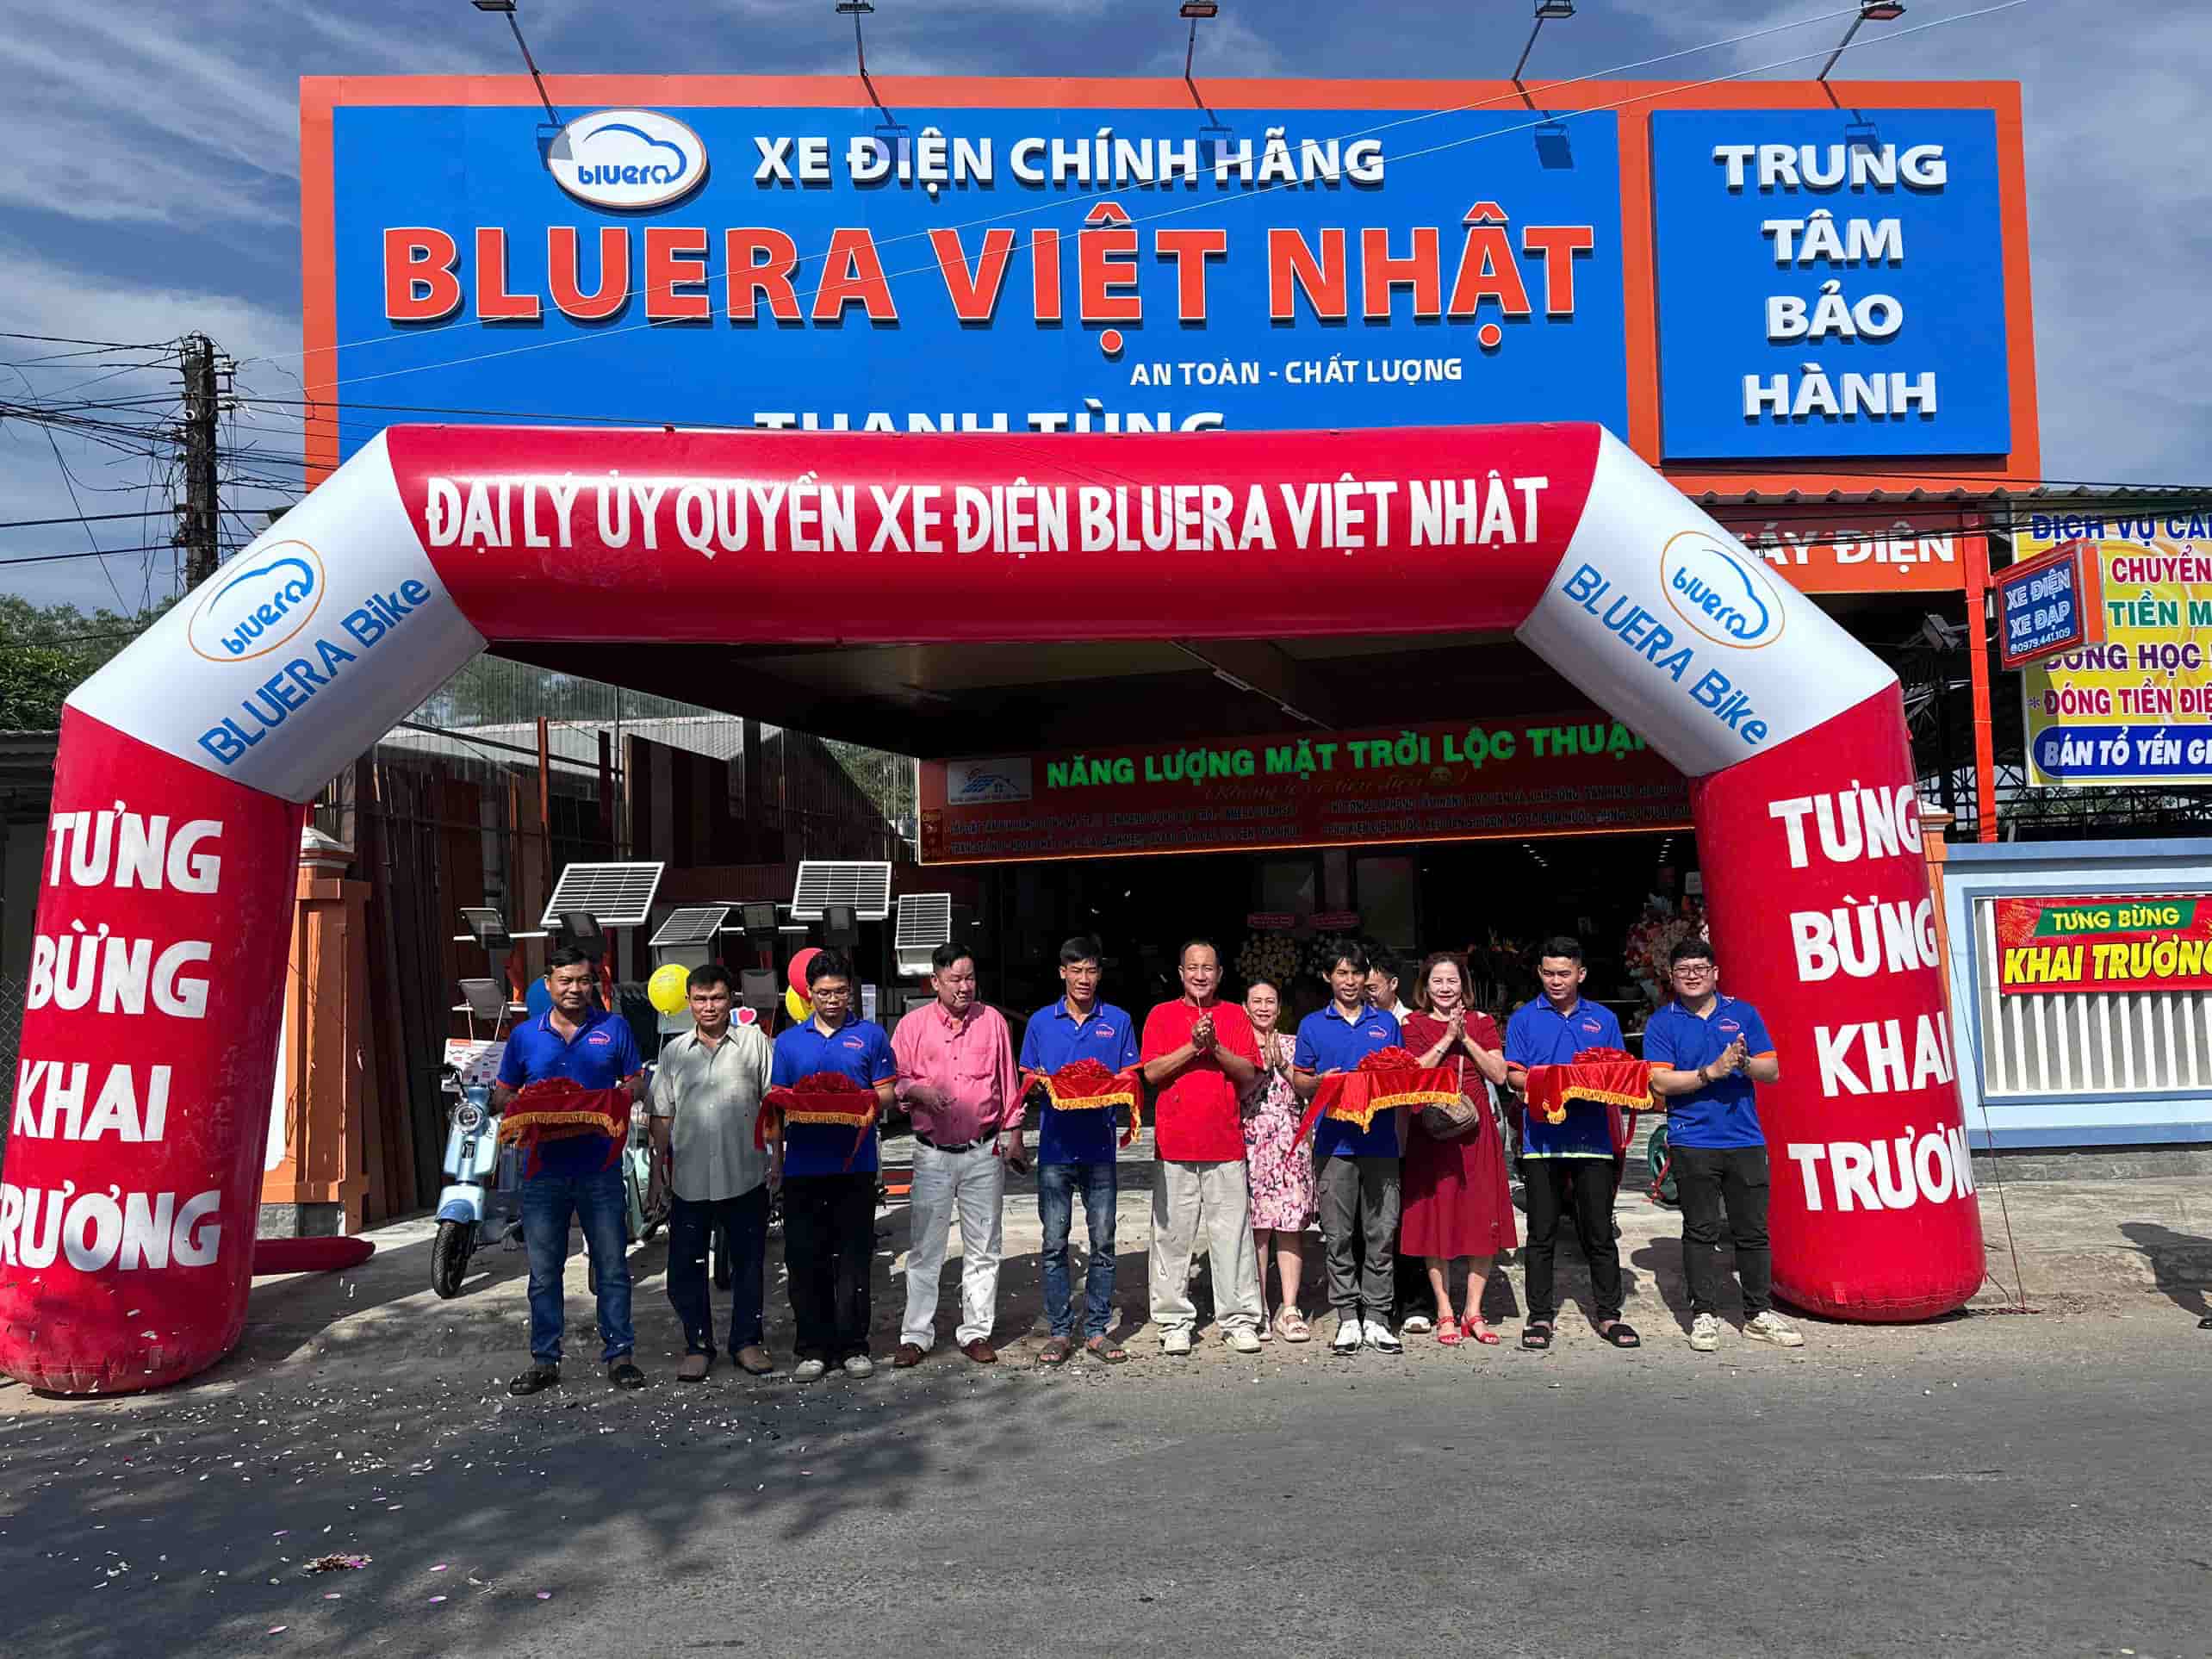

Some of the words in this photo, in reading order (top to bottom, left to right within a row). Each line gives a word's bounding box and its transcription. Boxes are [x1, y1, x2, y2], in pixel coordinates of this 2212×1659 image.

[578, 165, 675, 184] bluera
[755, 136, 830, 181] XE
[848, 127, 992, 195] ĐIỆN
[1010, 127, 1198, 183] CHÍNH
[1215, 127, 1385, 185] HÃNG
[1712, 144, 1947, 188] TRUNG
[1762, 208, 1904, 264] TÂM
[383, 227, 899, 322] BLUERA
[929, 202, 1227, 354] VIỆT
[1267, 201, 1595, 349] NHẬT
[1766, 279, 1904, 339] BẢO
[1130, 363, 1172, 386] AN
[1178, 357, 1260, 385] TOÀN
[1285, 353, 1360, 384] CHẤT
[1367, 357, 1463, 386] LƯỢNG
[1743, 363, 1937, 419] HÀNH
[426, 477, 512, 554] ĐẠI
[599, 469, 668, 550] ỦY
[674, 470, 858, 560] QUYỀN
[868, 484, 944, 554] XE
[954, 476, 1068, 558] ĐIỆN
[1079, 483, 1277, 553] BLUERA
[1278, 473, 1398, 556] VIỆT
[1409, 469, 1549, 550] NHẬT
[2032, 513, 2105, 545] DỊCH
[2116, 515, 2155, 547] VỤ
[1735, 522, 1819, 565] ÁY
[1832, 521, 1954, 574] ĐIỆN
[2111, 544, 2212, 582] CHUYỂN
[221, 579, 308, 656] bluera
[1672, 567, 1749, 638] bluera
[2006, 586, 2028, 611] XE
[2030, 568, 2071, 602] ĐIỆN
[2108, 589, 2178, 626] TIỀN
[2010, 613, 2032, 640] XE
[2034, 600, 2071, 631] ĐẠP
[197, 638, 357, 765] BLUERA
[340, 579, 431, 648] Bike
[1563, 563, 1694, 682] BLUERA
[1688, 668, 1768, 745] Bike
[2138, 643, 2202, 677] HỌC
[2044, 682, 2111, 714] ĐÓNG
[2118, 678, 2173, 714] TIỀN
[1047, 755, 1135, 787] NĂNG
[1145, 747, 1255, 786] LƯỢNG
[1264, 738, 1339, 780] MẶT
[1347, 730, 1432, 770] TRỜI
[1442, 725, 1518, 769] LỘC
[2044, 733, 2094, 767] BÁN
[2099, 726, 2131, 766] TỔ
[2135, 728, 2183, 766] YẾN
[48, 800, 224, 894] TƯNG
[1768, 780, 1923, 868] TƯNG
[1789, 895, 1940, 982] BỪNG
[2118, 904, 2180, 928] BỪNG
[28, 919, 212, 1019] BỪNG
[2004, 945, 2085, 985] KHAI
[1814, 1011, 1954, 1097] KHAI
[13, 1059, 171, 1142] KHAI
[1787, 1122, 1976, 1212] TRƯƠN
[0, 1179, 221, 1271] RƯƠNG
